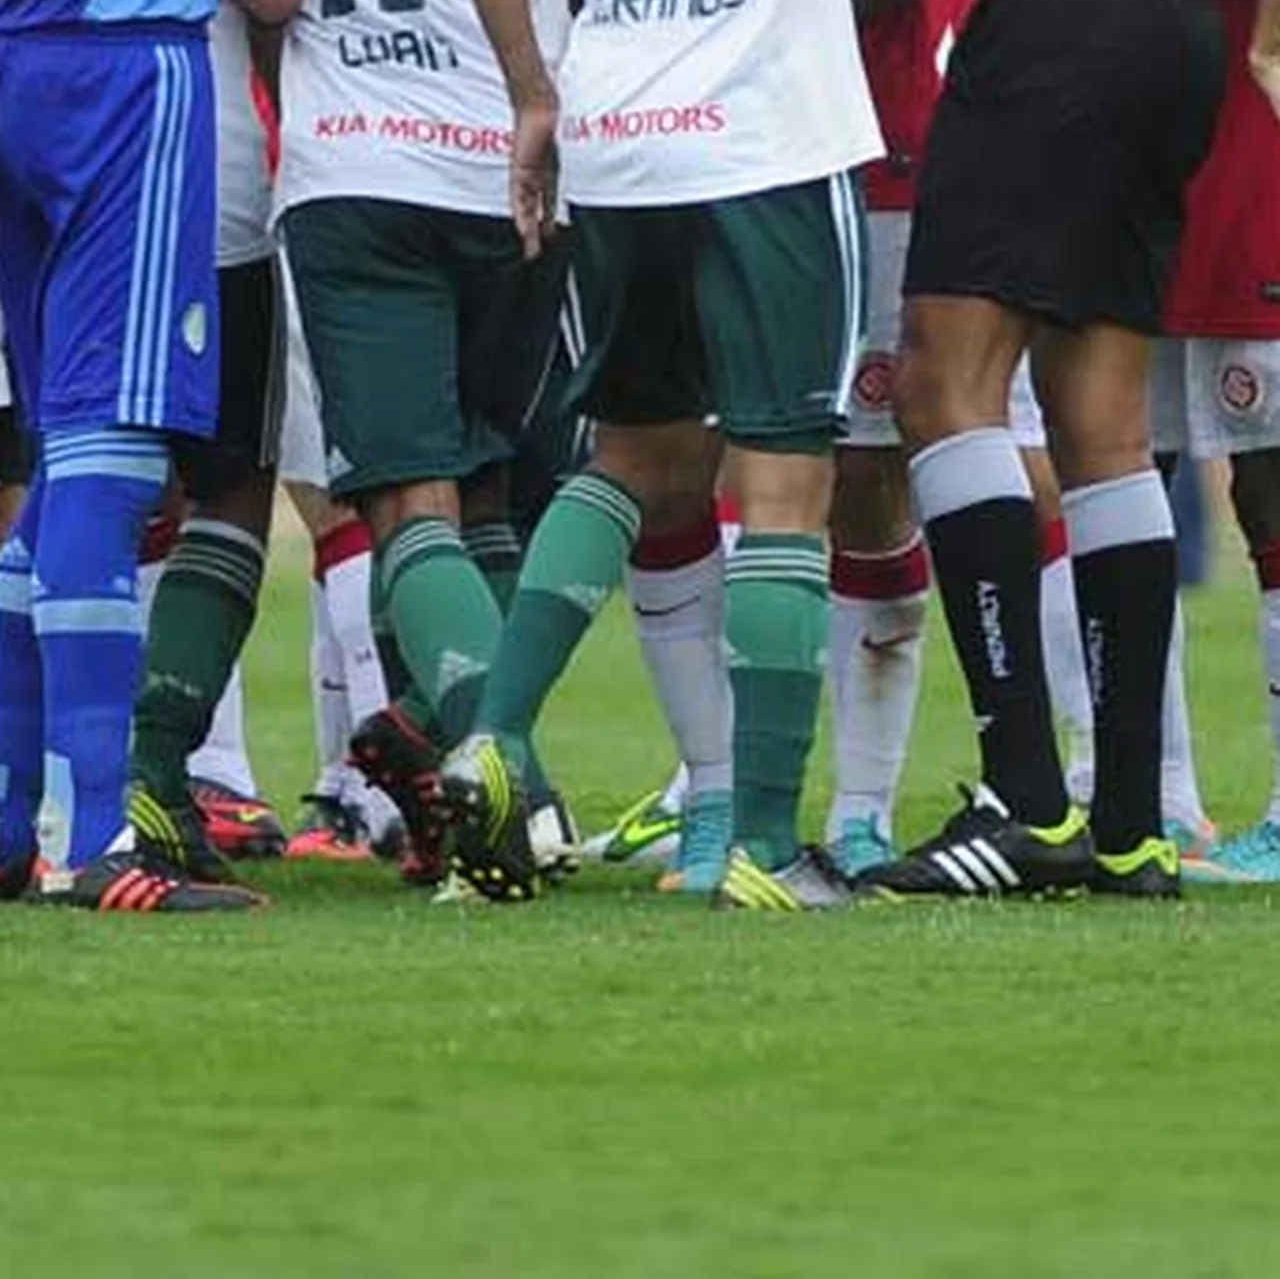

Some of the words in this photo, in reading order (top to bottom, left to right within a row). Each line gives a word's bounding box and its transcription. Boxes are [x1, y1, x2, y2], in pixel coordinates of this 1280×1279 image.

[338, 29, 459, 71] LUAN
[315, 112, 368, 137] KIA
[601, 103, 726, 141] MOTORS
